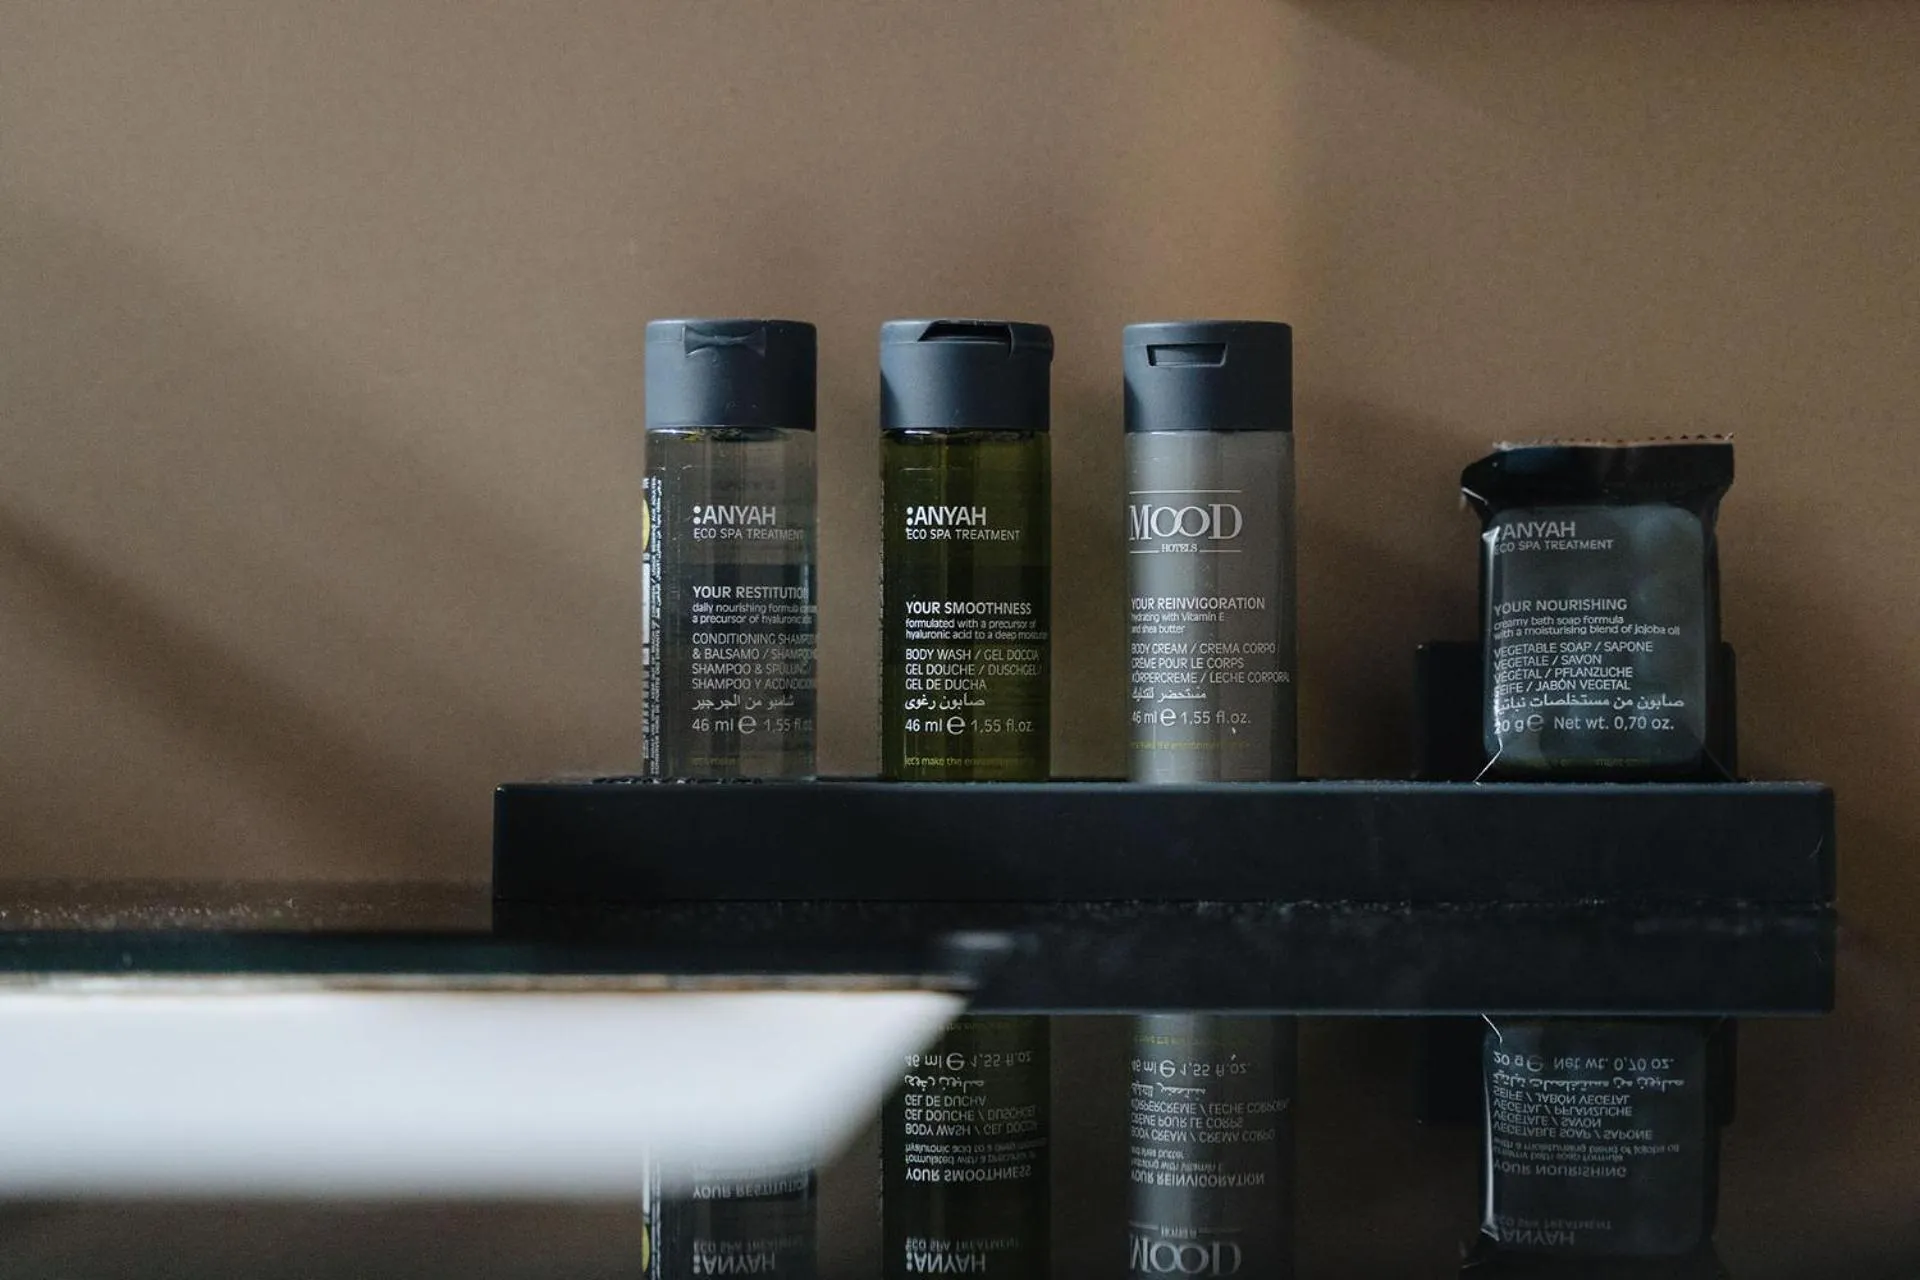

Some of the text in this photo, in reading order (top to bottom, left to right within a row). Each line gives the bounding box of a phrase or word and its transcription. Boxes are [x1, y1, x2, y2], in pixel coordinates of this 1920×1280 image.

[1129, 503, 1243, 540] MOOD
[693, 528, 804, 541] ECO SPA TREATMENT
[906, 528, 1021, 542] ECO SPA TREATMENT
[1161, 543, 1198, 553] HOTELS
[1519, 541, 1541, 551] SPA
[1544, 539, 1614, 551] TREATMENT
[692, 585, 731, 599] YOUR
[692, 603, 767, 616] daily nourishing
[905, 601, 1032, 615] YOUR SMOOTHNESS
[1131, 597, 1266, 610] YOUR REINVIGORATION
[1494, 599, 1628, 616] YOUR NOURISHING
[700, 615, 747, 625] precursor
[749, 614, 760, 624] of
[905, 617, 955, 629] formulated
[956, 617, 978, 629] with
[980, 620, 987, 629] a
[1162, 611, 1179, 622] with
[1181, 611, 1217, 622] Vitamin
[1219, 612, 1225, 622] E
[1531, 616, 1554, 626] bath
[1556, 617, 1581, 627] soap
[1583, 614, 1624, 625] formula
[905, 628, 950, 641] hyaluronic
[952, 628, 972, 640] acid
[974, 629, 985, 640] to
[987, 631, 993, 640] a
[1159, 624, 1185, 634] butter
[1516, 629, 1522, 637] a
[1524, 625, 1587, 637] moisturising
[1589, 624, 1618, 634] blend
[1621, 623, 1633, 634] of
[1634, 624, 1666, 636] jojoba
[692, 632, 776, 645] CONDITIONING
[704, 648, 760, 660] BALSAMO
[905, 648, 935, 661] BODY
[937, 648, 972, 661] WASH
[983, 648, 1004, 661] GEL
[1151, 643, 1188, 655] CREAM
[1200, 643, 1240, 654] CREMA
[1242, 643, 1276, 655] CORPO
[1494, 642, 1557, 659] VEGETABLE
[1560, 642, 1592, 653] SOAP
[1603, 641, 1653, 652] SAPONE
[692, 663, 751, 675] SHAMPOO
[1158, 657, 1188, 669] POUR
[1191, 657, 1204, 669] LE
[1206, 657, 1244, 669] CORPS
[1494, 655, 1550, 671] VEGETALE
[1561, 654, 1602, 666] SAVON
[905, 663, 923, 676] GEL
[926, 663, 975, 676] DOUCHE
[692, 678, 761, 690] SHAMPOO Y
[905, 678, 987, 690] GEL DE DUCHA
[1209, 672, 1244, 684] LECHE
[1535, 677, 1576, 692] JABÓN
[1579, 679, 1631, 691] VEGETAL
[939, 692, 986, 710] صابون
[1613, 697, 1633, 710] من
[1637, 693, 1685, 710] صابون
[1143, 710, 1158, 724] ml
[692, 719, 709, 732] 46
[714, 719, 734, 732] ml
[905, 718, 920, 732] 46
[925, 718, 943, 732] ml
[1514, 719, 1524, 733] g
[1553, 716, 1581, 730] Net
[1585, 717, 1609, 730] wt.
[1651, 718, 1674, 730] oz.
